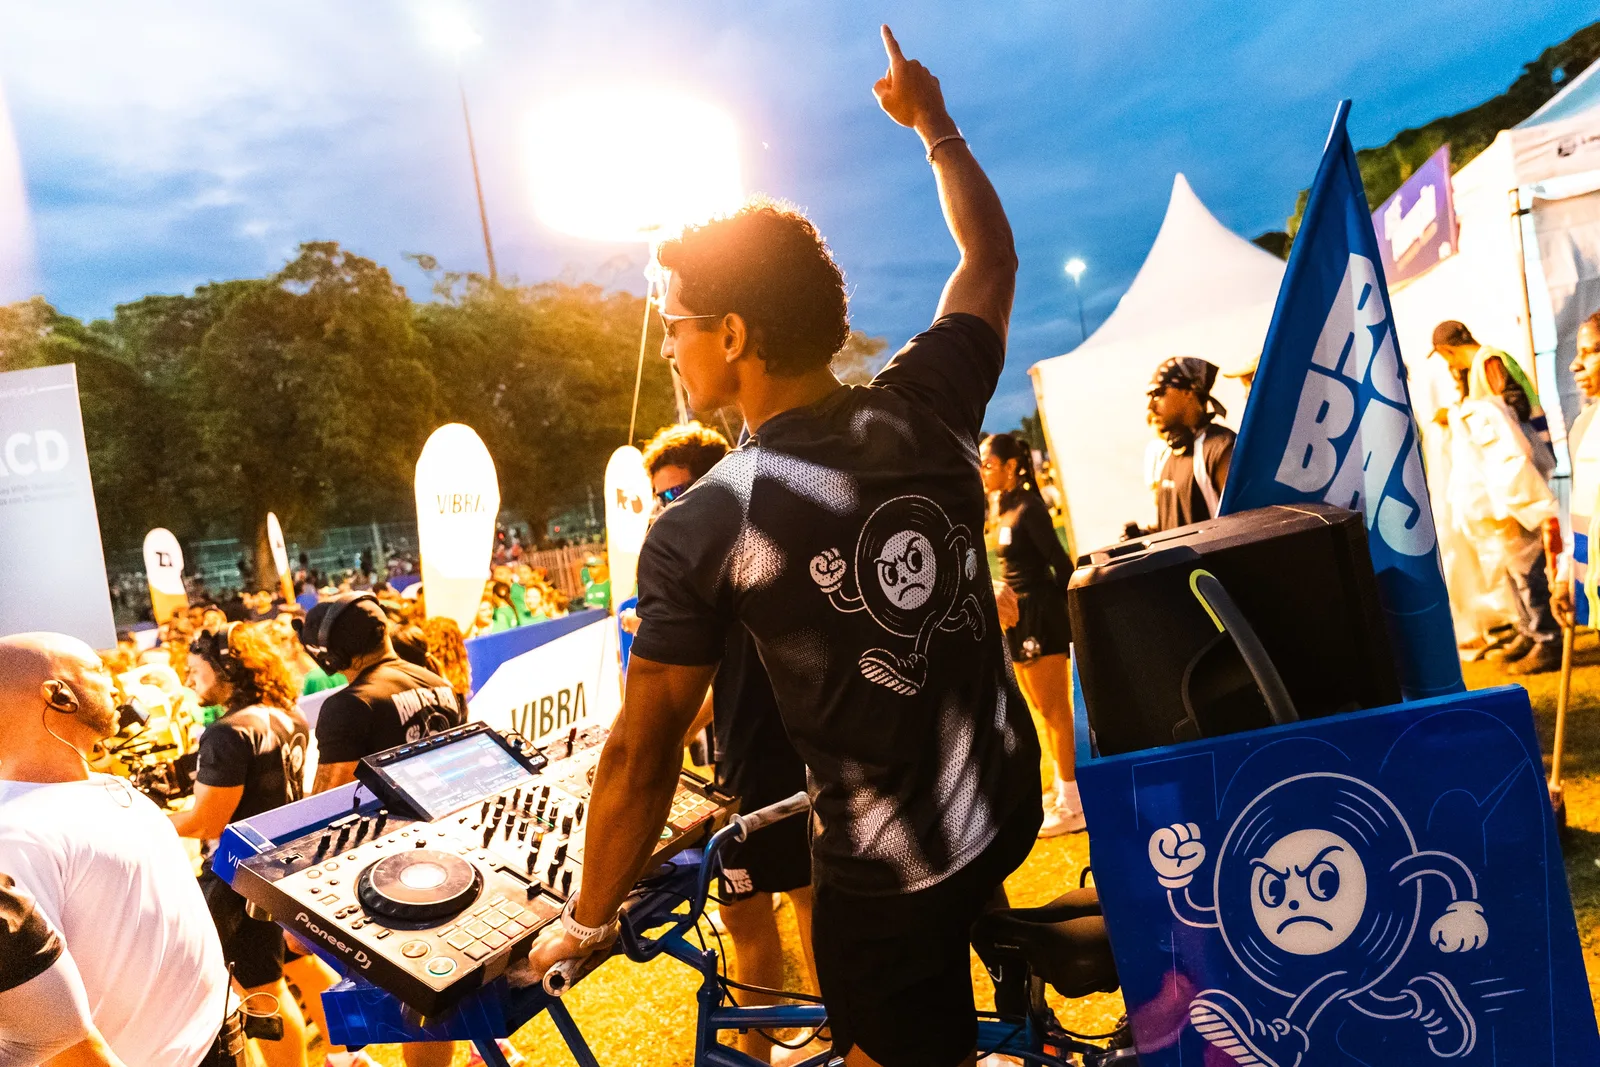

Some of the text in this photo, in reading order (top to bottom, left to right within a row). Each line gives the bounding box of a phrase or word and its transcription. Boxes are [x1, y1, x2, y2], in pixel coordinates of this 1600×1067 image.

[0, 430, 70, 477] CD
[511, 682, 587, 742] VIBRA
[228, 851, 242, 869] VI
[295, 911, 354, 954] Pioneer
